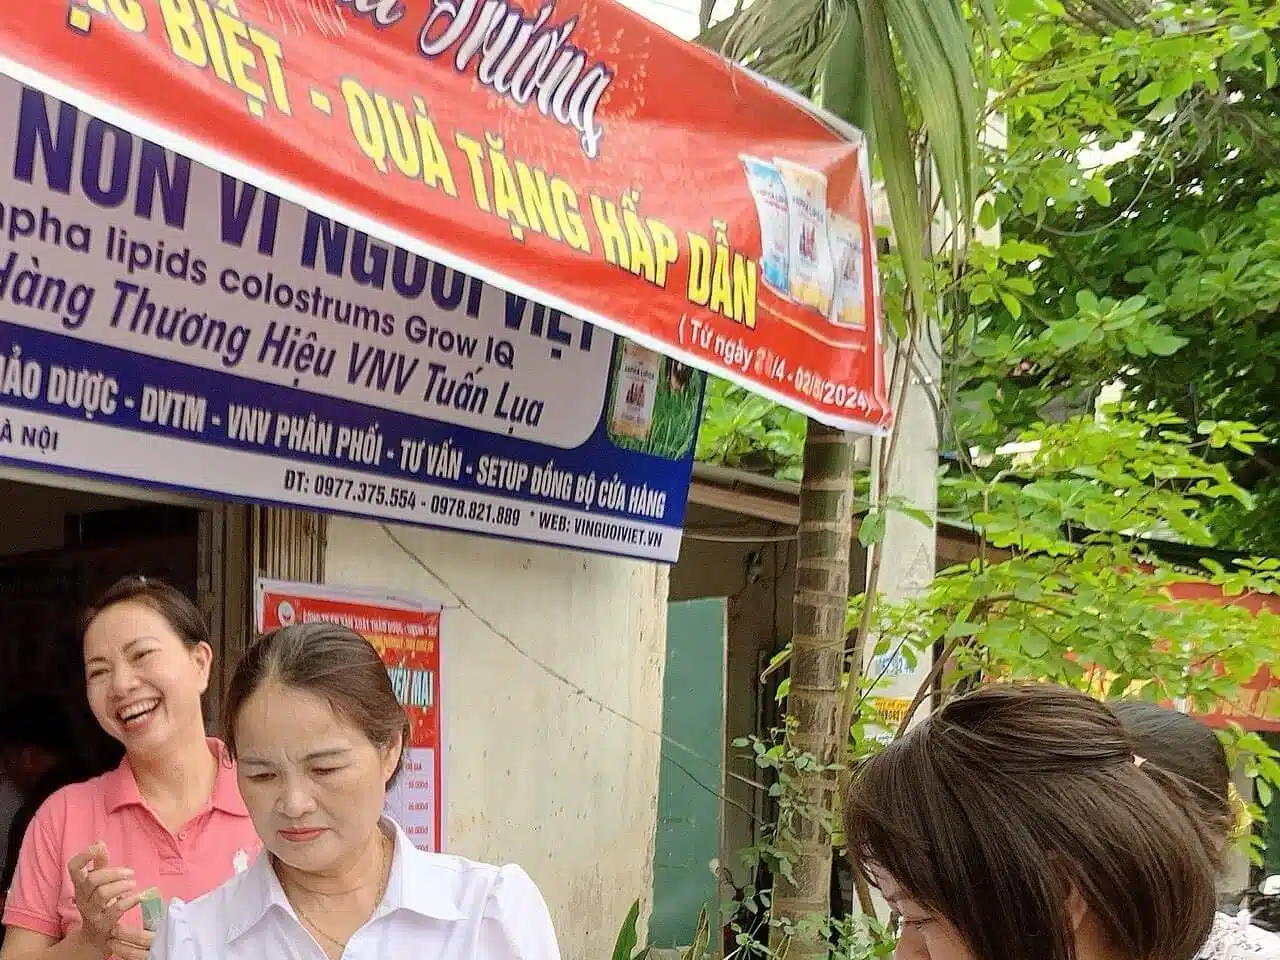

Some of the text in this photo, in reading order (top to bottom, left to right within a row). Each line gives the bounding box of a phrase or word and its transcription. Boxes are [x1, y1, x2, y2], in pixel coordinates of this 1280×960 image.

[340, 77, 458, 199] QUÀ
[455, 130, 591, 254] TẶNG
[589, 185, 679, 288] HẤP
[686, 217, 758, 329] DẪN
[106, 225, 207, 284] lipids
[219, 266, 394, 337] colostrums
[405, 315, 478, 359] Grow
[485, 336, 515, 369] IQ
[109, 281, 251, 367] Thương
[258, 320, 336, 387] Hiệu
[347, 341, 419, 396] VNV
[423, 363, 489, 415] Tuấn
[493, 381, 544, 434] Lụa
[714, 334, 753, 373] ngày
[21, 425, 59, 454] NỘI
[47, 366, 119, 420] DƯỢC
[140, 384, 207, 432] DVTM
[227, 404, 271, 445] VNV
[274, 413, 333, 456] PHÂN
[400, 439, 426, 473] TƯ
[426, 437, 463, 481] VẤN
[476, 455, 529, 492] SETUP
[575, 471, 596, 511] BỘ
[598, 473, 625, 512] CỬA
[628, 481, 667, 519] HÀNG
[284, 469, 310, 494] ĐT:
[314, 474, 417, 511] 0977.375.554
[430, 496, 520, 527] 0978.821.889
[536, 512, 571, 533] WEB:
[573, 518, 663, 548] VINGUOIVIET.VN
